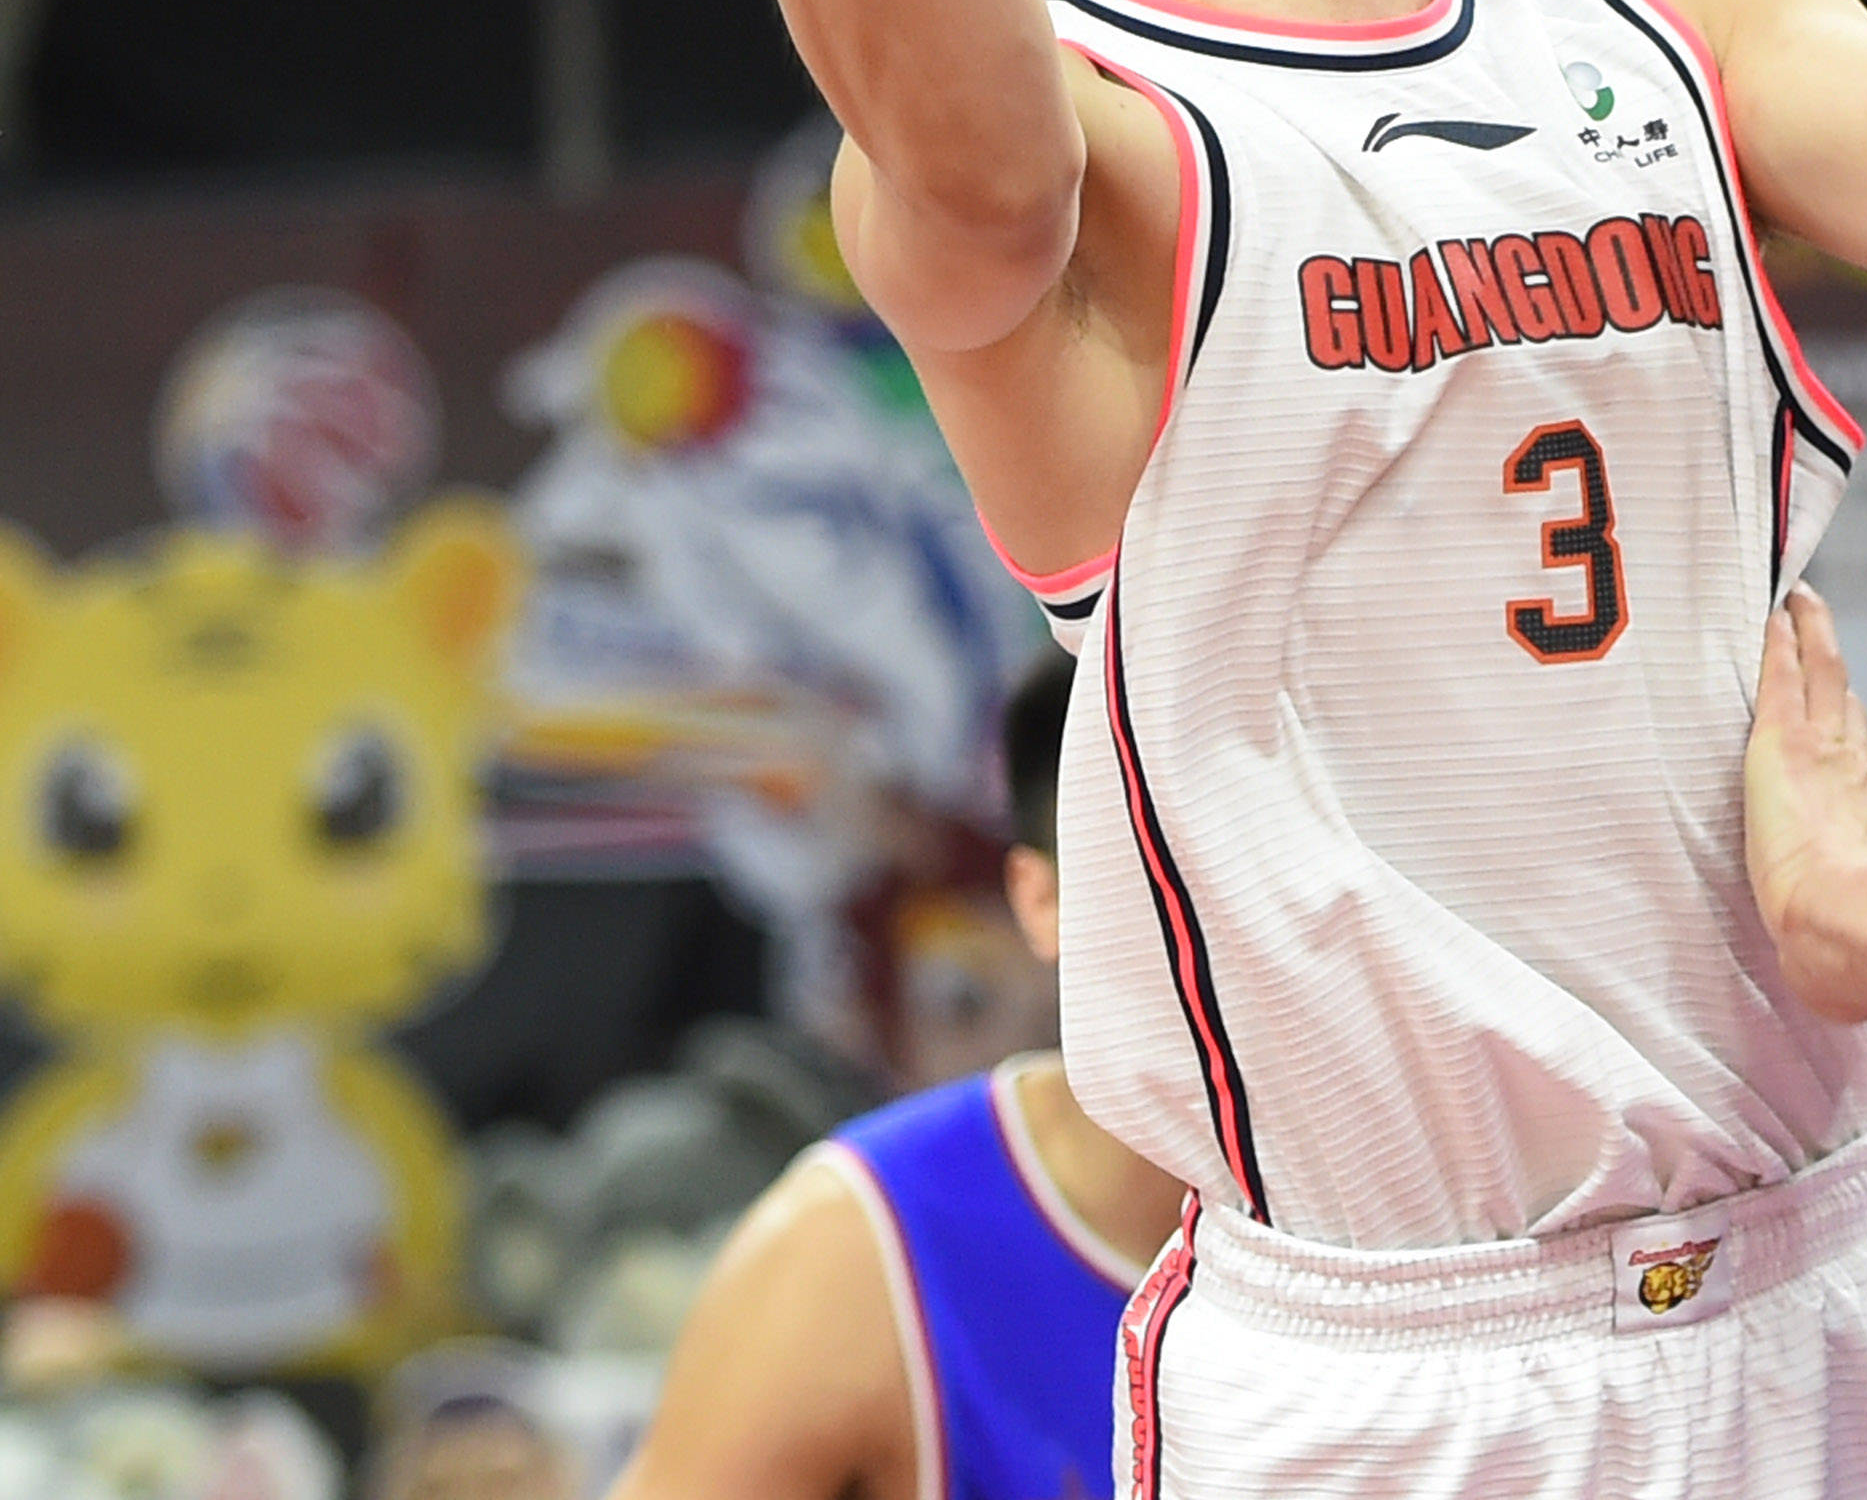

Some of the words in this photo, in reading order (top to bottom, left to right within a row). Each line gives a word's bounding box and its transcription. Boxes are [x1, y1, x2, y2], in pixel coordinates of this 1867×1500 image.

[1634, 143, 1679, 168] LIFE
[1297, 212, 1724, 375] GUANGDONG
[1502, 418, 1630, 665] 3
